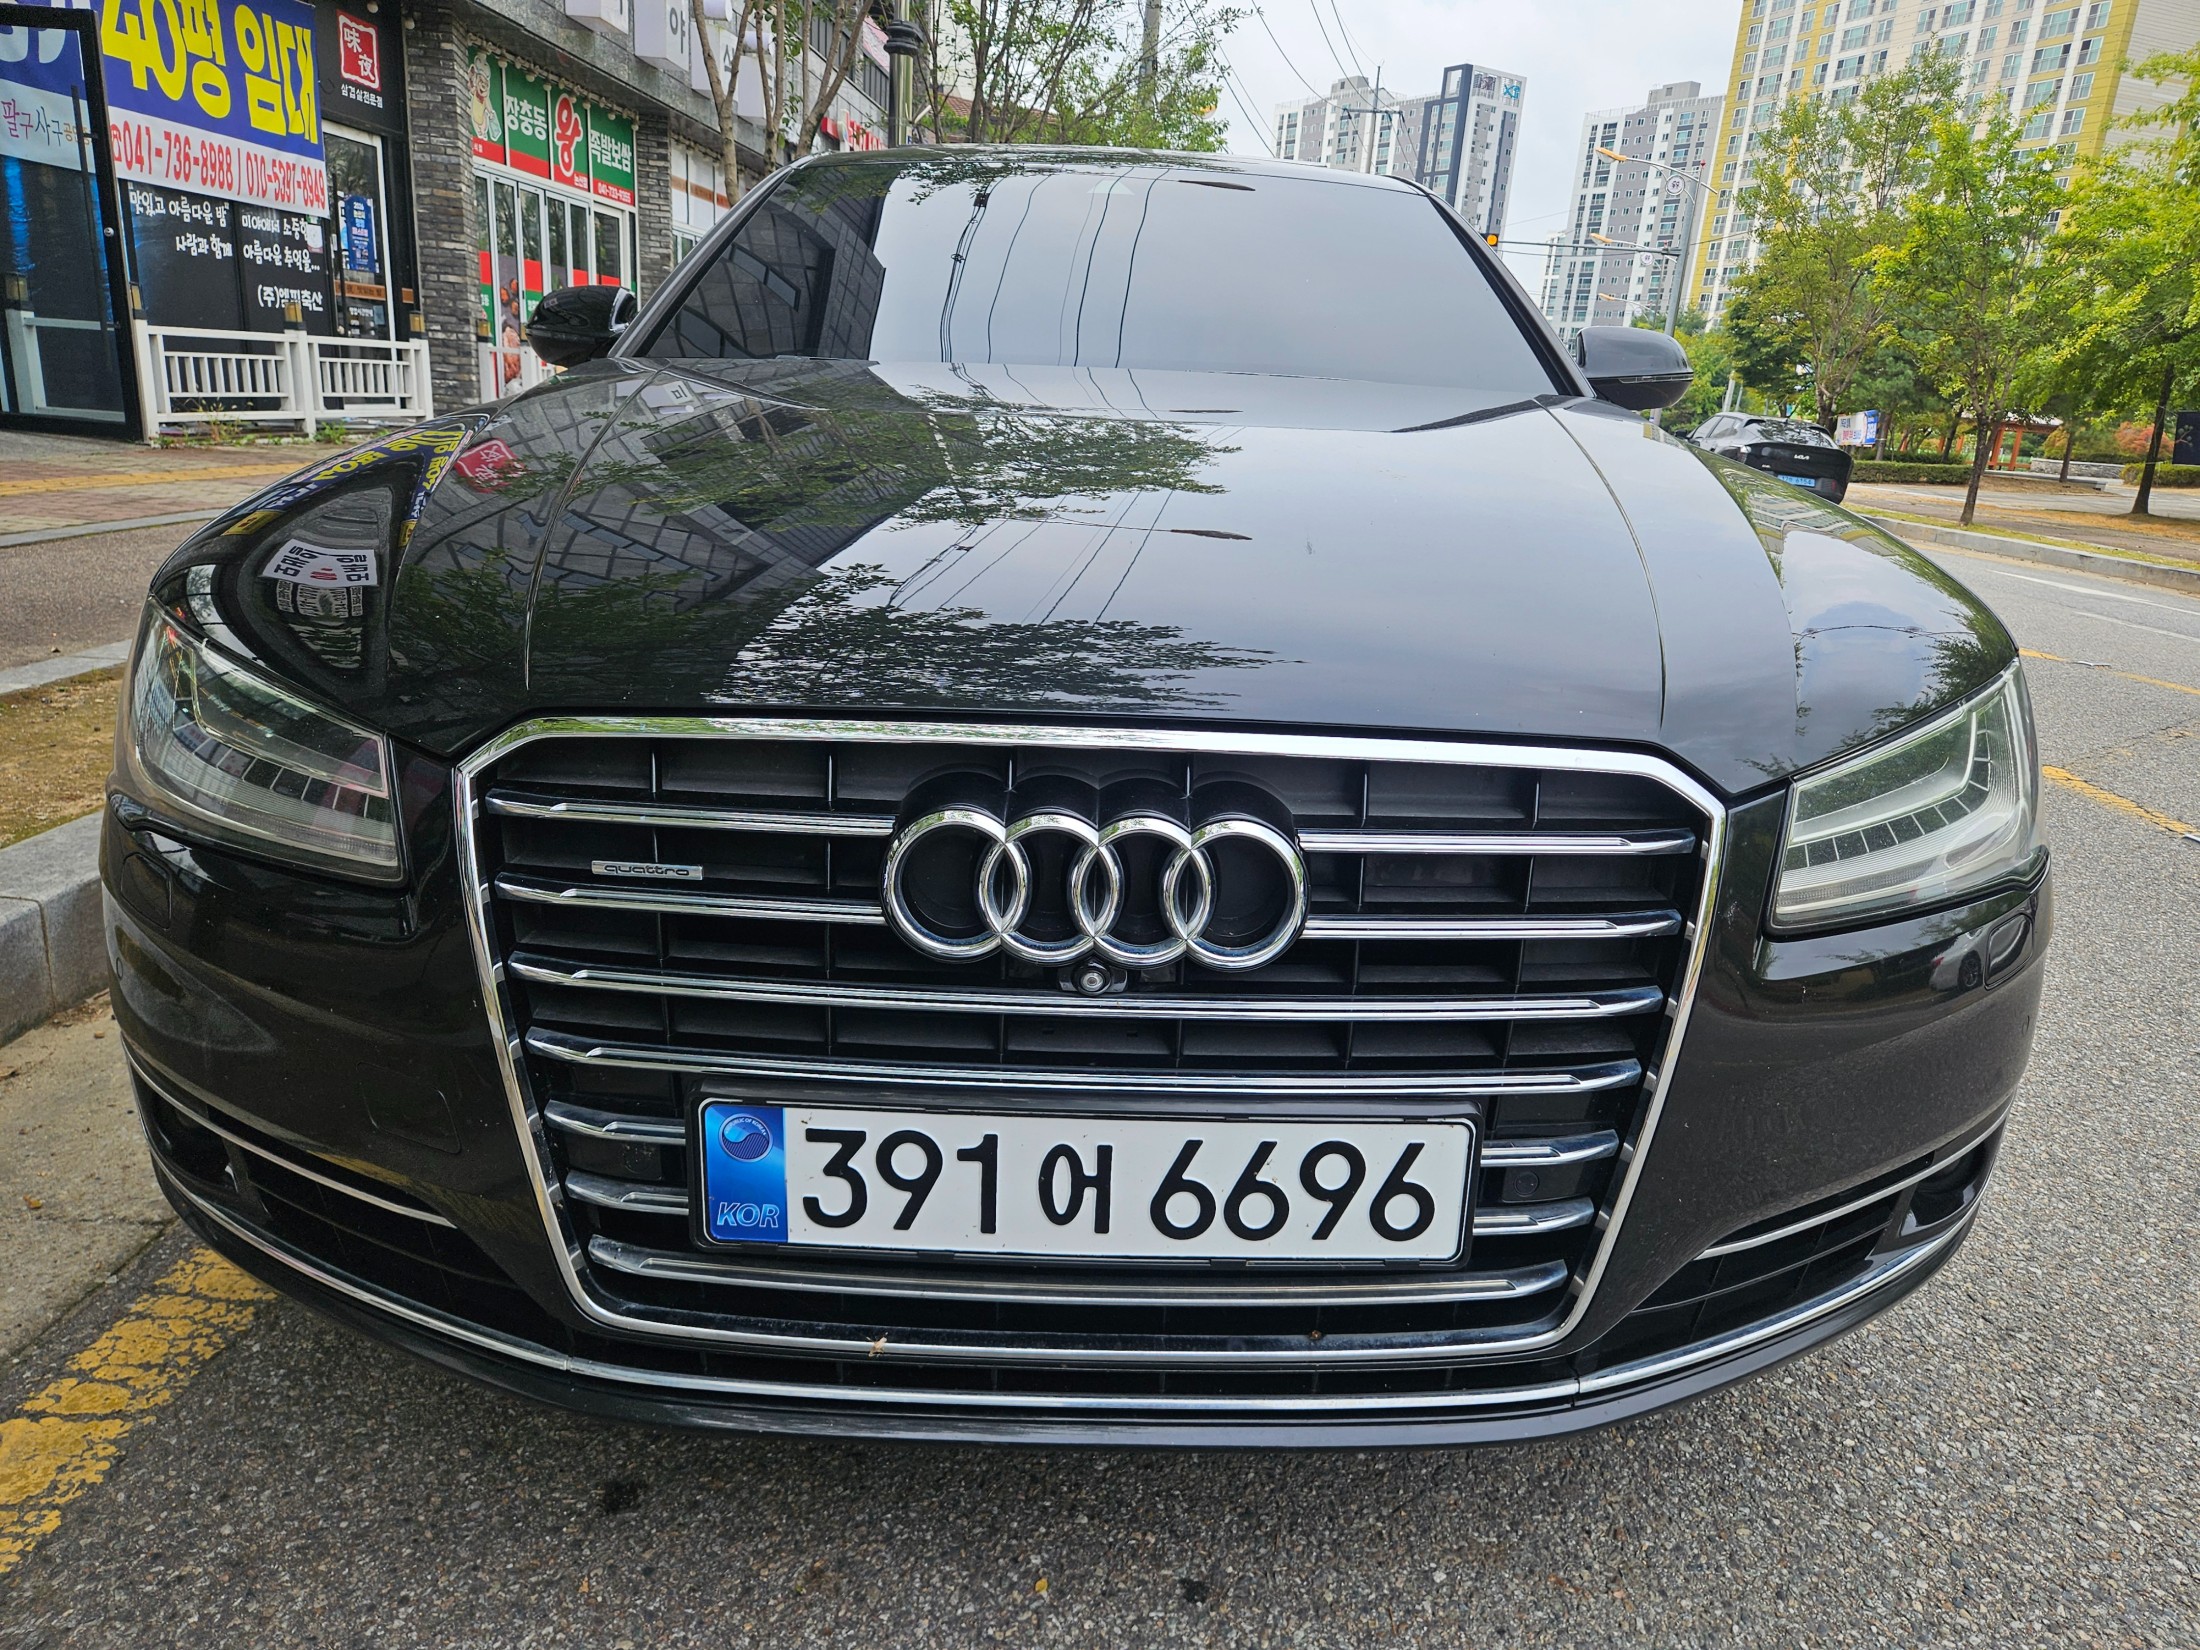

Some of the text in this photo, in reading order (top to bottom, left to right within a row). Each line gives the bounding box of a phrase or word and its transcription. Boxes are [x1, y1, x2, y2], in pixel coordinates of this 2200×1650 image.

[101, 0, 318, 145] 40평 임대
[341, 84, 383, 108] 삼겹살전문점
[506, 94, 632, 175] 장충동 왕 족발보쌈
[123, 121, 233, 191] 041-736-8988
[246, 151, 326, 210] 010-5397-8949
[169, 195, 214, 225] 아름다운
[176, 233, 233, 260] 사람과 함께
[243, 240, 282, 266] 아름다운
[604, 864, 690, 876] quattro
[716, 1201, 780, 1228] KOR
